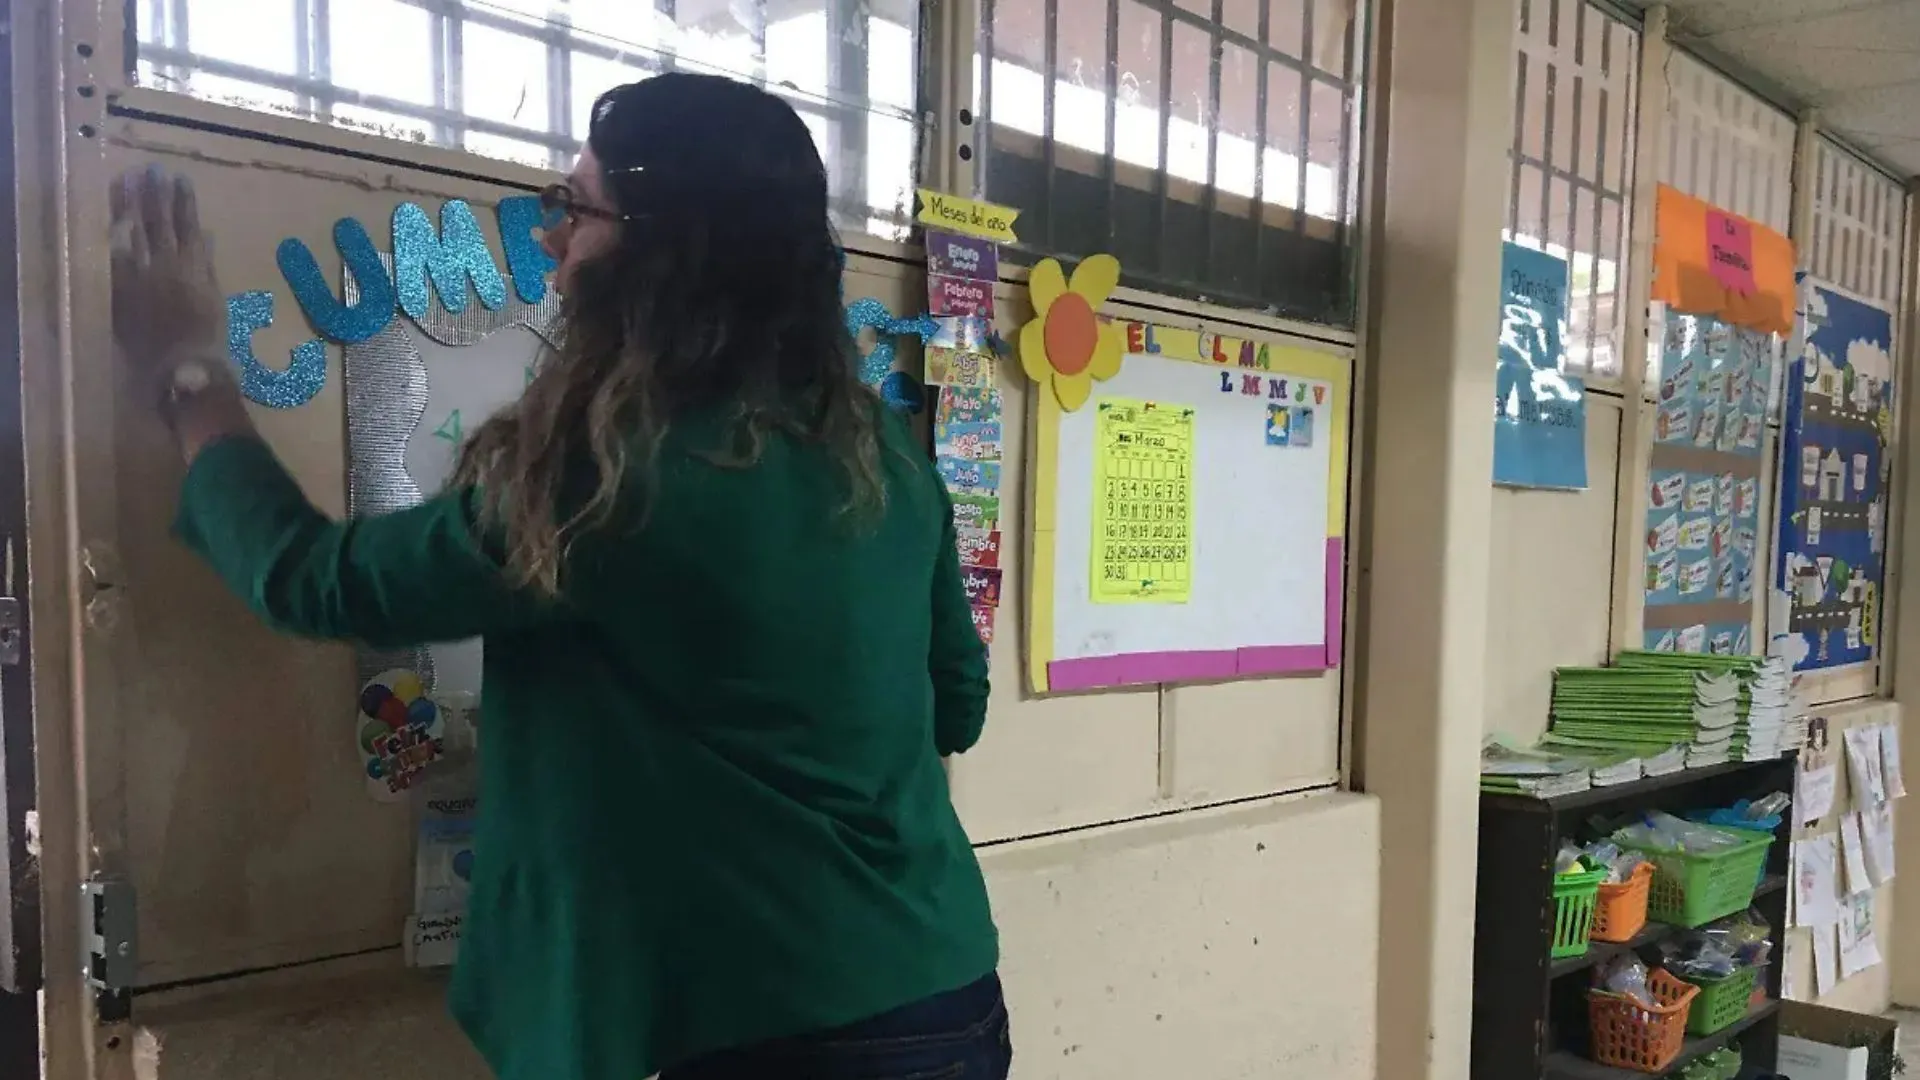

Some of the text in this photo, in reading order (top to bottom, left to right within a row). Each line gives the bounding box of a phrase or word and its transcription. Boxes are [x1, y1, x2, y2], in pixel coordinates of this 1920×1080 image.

[930, 196, 1006, 231] Meses del año
[947, 243, 980, 263] Enero
[944, 282, 983, 299] Febrero
[1126, 321, 1161, 353] EL
[1220, 370, 1326, 405] L M M J V
[953, 395, 982, 410] Mayo
[1135, 431, 1166, 448] Marzo
[1107, 482, 1114, 497] 2
[953, 503, 982, 517] gosto
[1107, 501, 1114, 516] 9
[1154, 503, 1162, 519] 13
[1105, 525, 1115, 537] 16
[963, 572, 988, 588] ubre
[971, 610, 988, 624] bre
